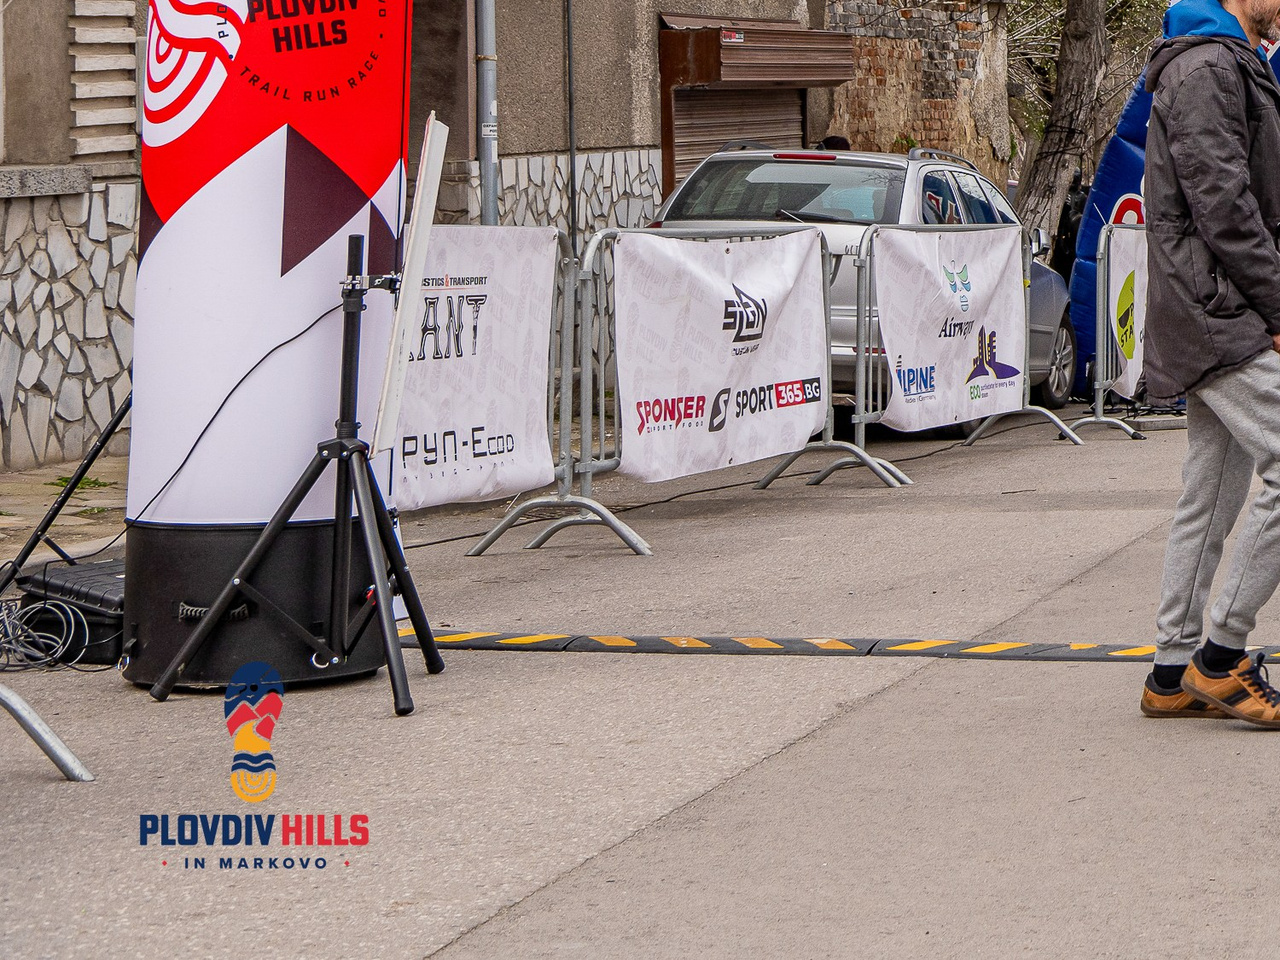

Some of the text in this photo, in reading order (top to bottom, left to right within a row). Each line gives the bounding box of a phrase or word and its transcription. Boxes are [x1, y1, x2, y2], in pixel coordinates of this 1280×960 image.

[272, 19, 348, 53] HILLS
[240, 51, 379, 102] TRAIL RUN RACE
[409, 294, 487, 361] ANT
[636, 396, 706, 435] SPONSER
